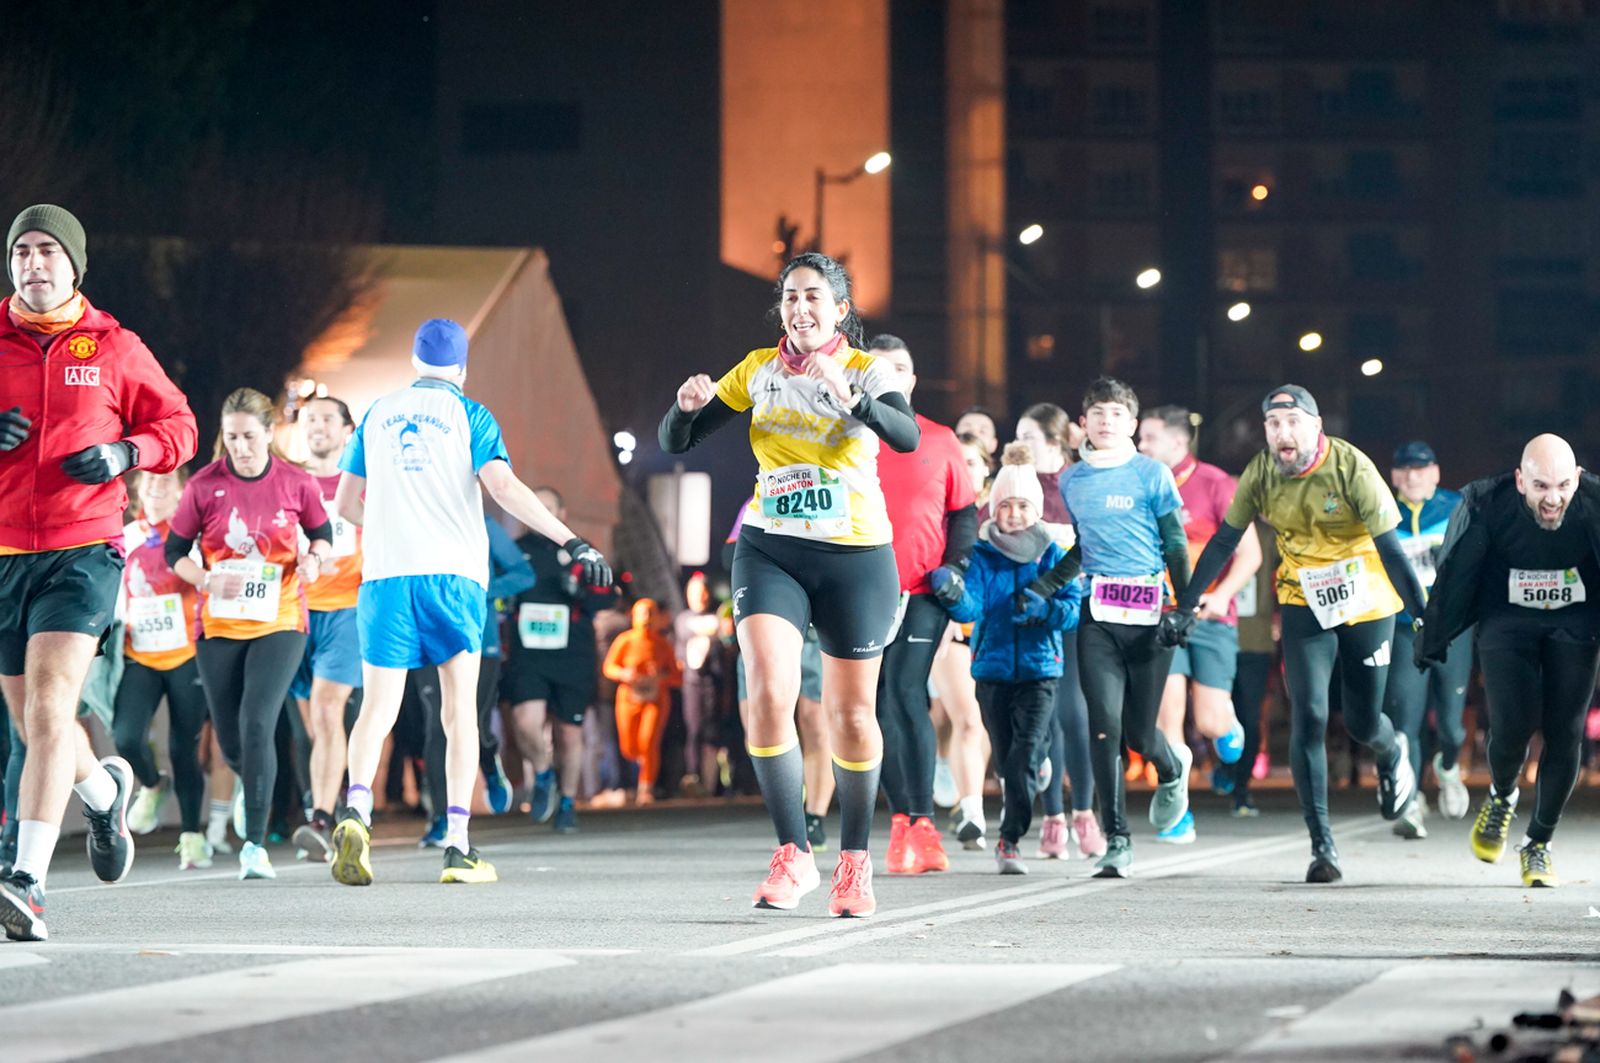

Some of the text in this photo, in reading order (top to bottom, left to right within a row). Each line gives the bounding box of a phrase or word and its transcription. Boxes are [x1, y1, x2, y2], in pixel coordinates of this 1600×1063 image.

[68, 368, 98, 384] AIG
[413, 414, 451, 434] RUNNING
[777, 472, 800, 484] NOCHE
[802, 471, 812, 479] DE
[770, 486, 786, 497] SAN
[776, 487, 832, 515] 8240
[1105, 495, 1134, 509] MIO
[1101, 584, 1154, 604] 15025
[1316, 580, 1355, 607] 5067
[1523, 587, 1572, 602] 5068
